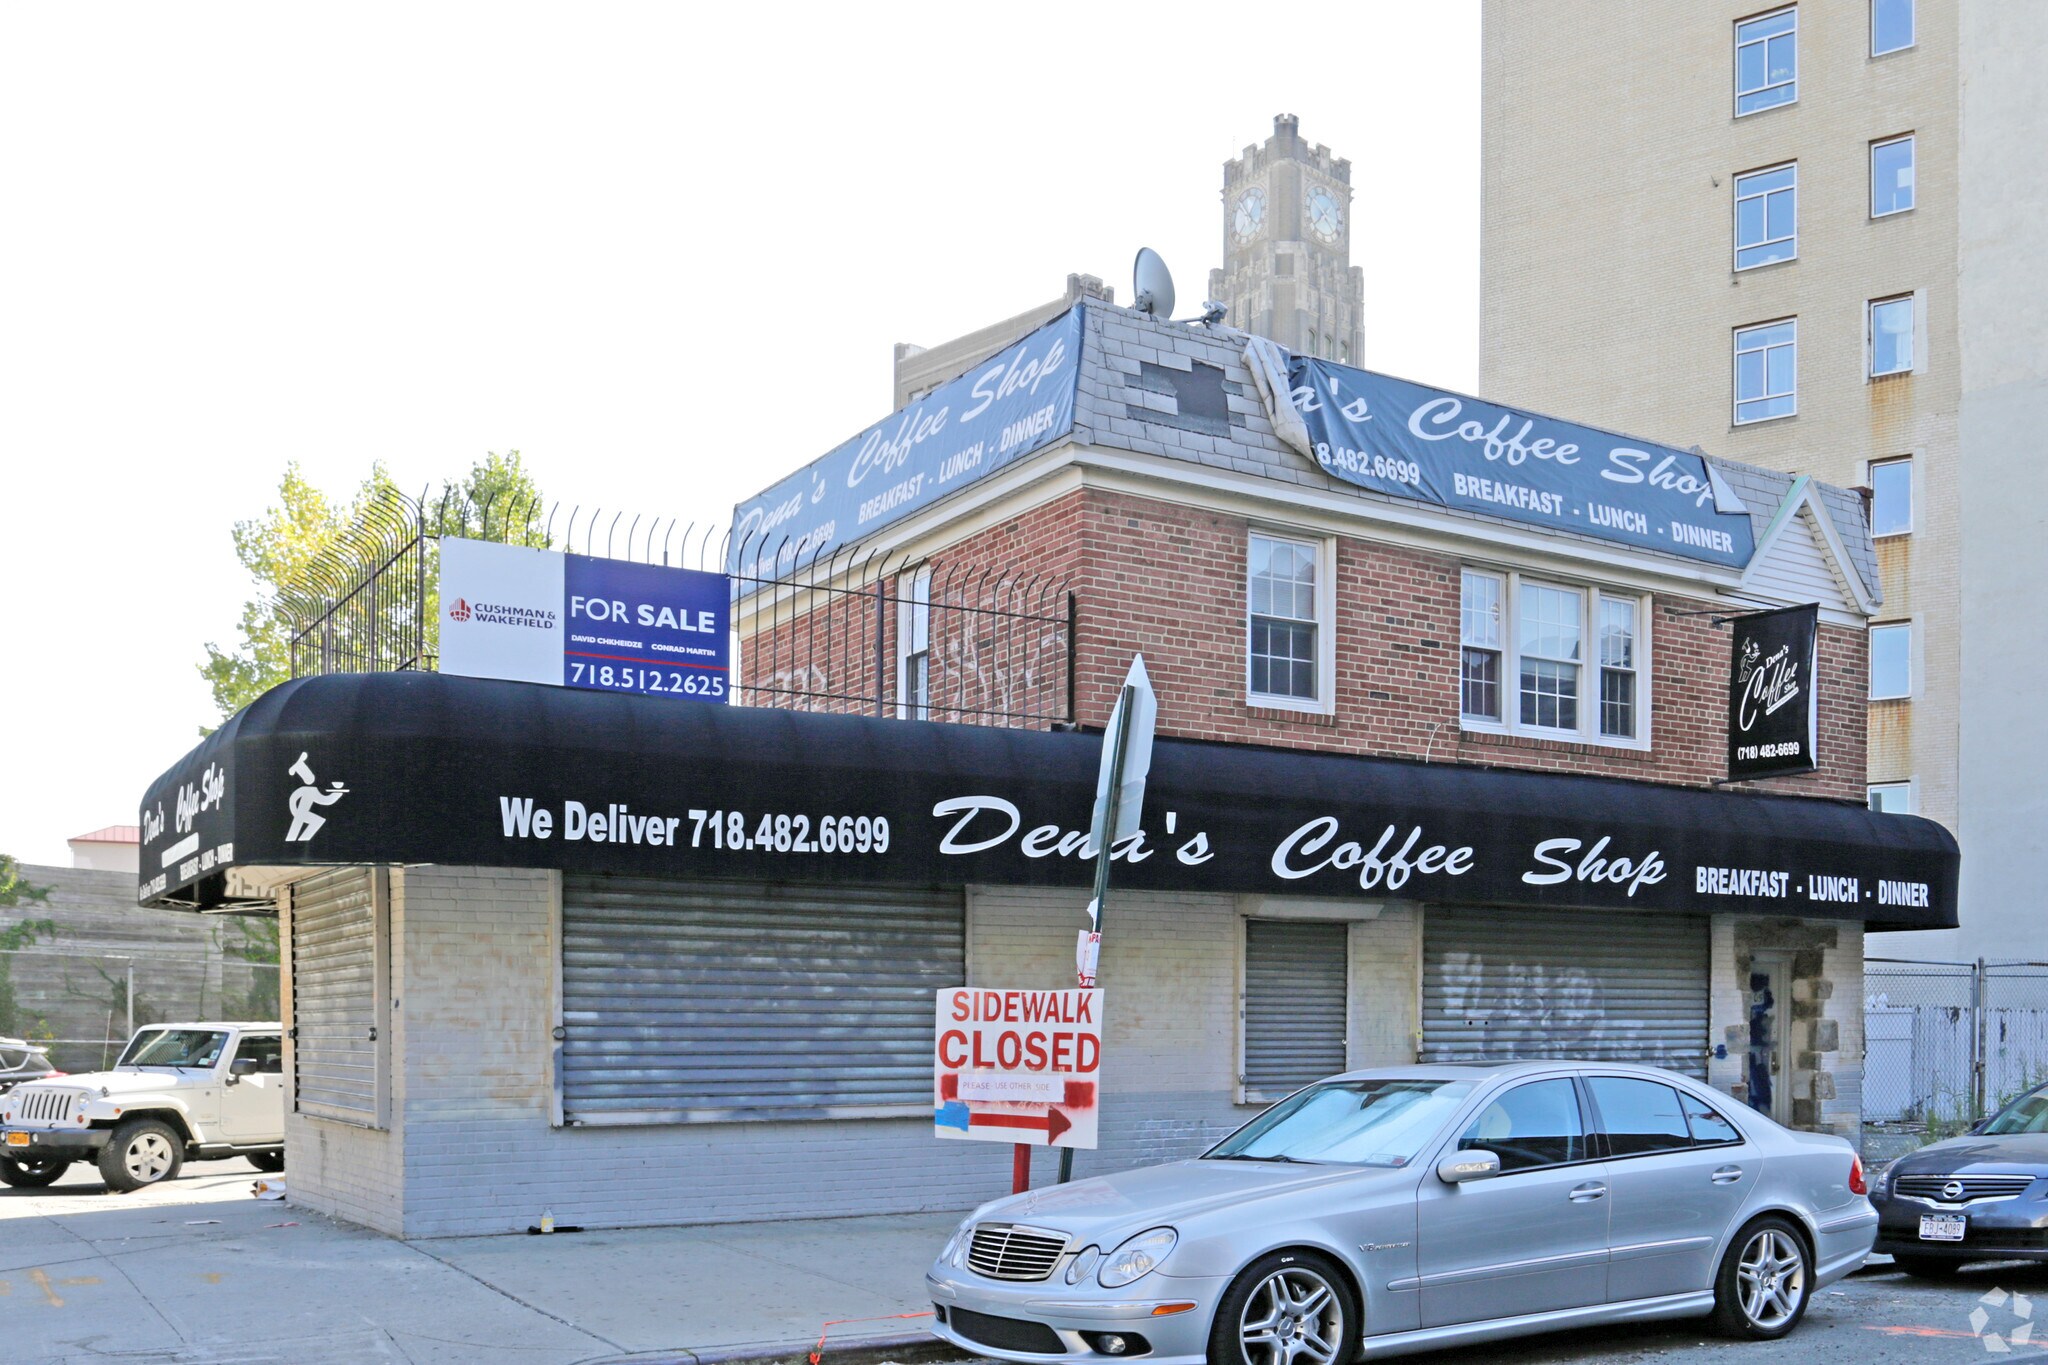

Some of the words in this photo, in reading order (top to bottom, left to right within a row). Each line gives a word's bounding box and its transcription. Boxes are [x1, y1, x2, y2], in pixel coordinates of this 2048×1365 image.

[846, 405, 950, 488] Coffee
[959, 337, 1065, 423] Shop
[1407, 397, 1581, 466] Coffee
[857, 472, 925, 526] BREAKFAST
[938, 440, 985, 485] LUNCH
[1000, 403, 1055, 453] DINNER
[1453, 472, 1563, 516] BREAKFAST
[1588, 502, 1648, 535] LUNCH
[1671, 521, 1734, 554] DINNER
[474, 603, 545, 619] CUSHMAN
[547, 610, 556, 620] &
[475, 612, 554, 629] WAKEFIELD
[570, 595, 630, 624] FOR
[637, 603, 716, 634] SALE
[570, 634, 596, 645] DAVID
[651, 643, 686, 654] CONRAD
[686, 647, 716, 657] MARTIN
[571, 662, 724, 697] 718.512.2625
[1737, 745, 1758, 761] (718)
[1760, 742, 1800, 758] 482-6699
[175, 782, 200, 834] Coffee
[201, 762, 225, 812] Shop
[499, 795, 553, 840] We
[563, 800, 680, 846] Deliver
[688, 808, 890, 854] 718.482.6699
[1271, 815, 1476, 891] Coffee
[1520, 835, 1668, 898] Shop
[1695, 866, 1790, 898] BREAKFAST
[1808, 874, 1859, 903] LUNCH
[1878, 880, 1930, 908] DINNER
[951, 991, 1093, 1024] SIDEWALK
[938, 1029, 1101, 1074] CLOSED
[994, 1081, 1008, 1091] USE
[1009, 1081, 1032, 1091] OTHER
